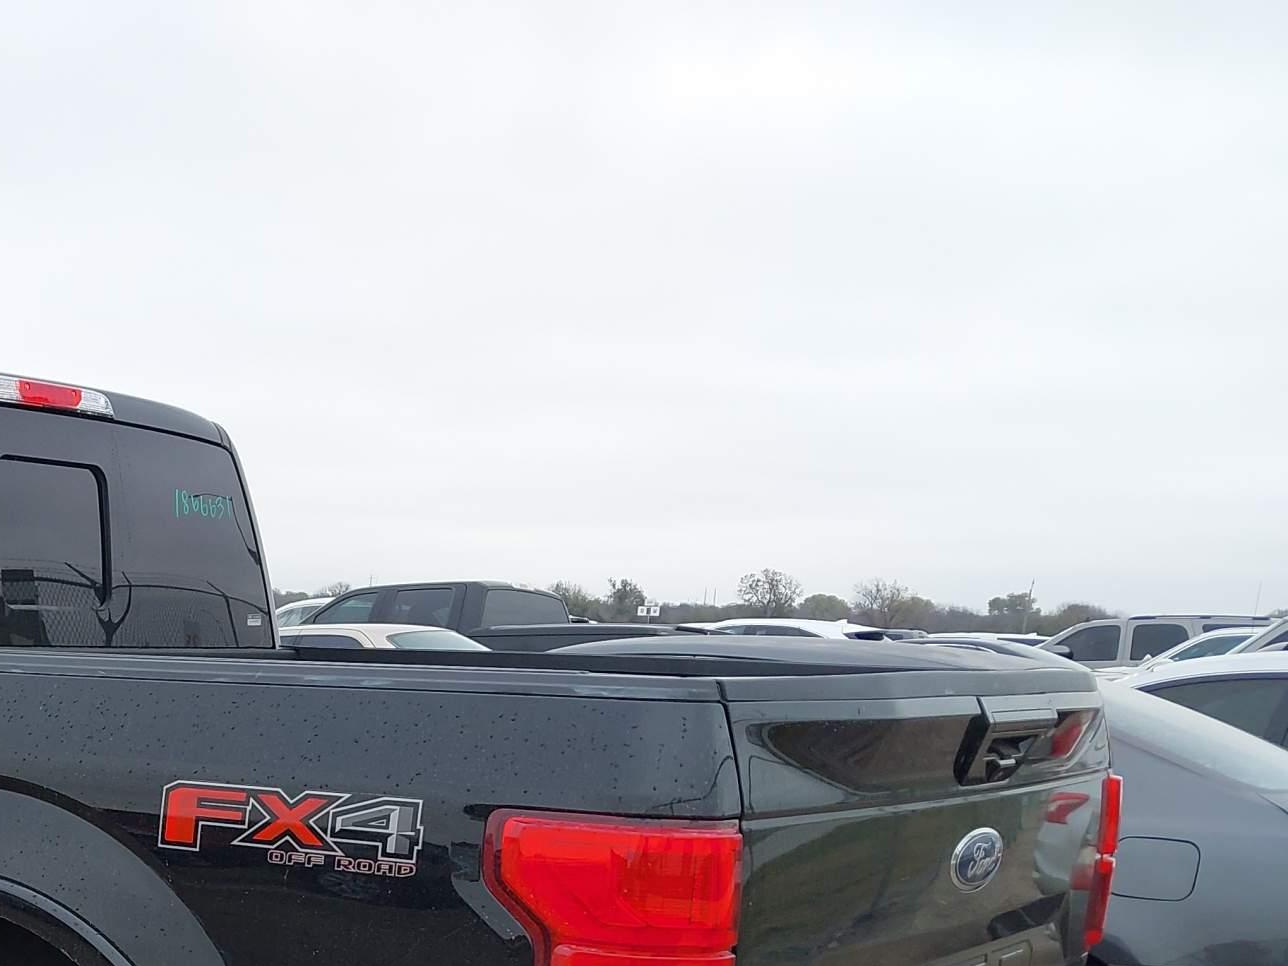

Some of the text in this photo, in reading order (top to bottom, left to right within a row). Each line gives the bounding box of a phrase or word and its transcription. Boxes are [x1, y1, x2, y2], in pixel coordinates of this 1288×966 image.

[158, 780, 423, 863] FX4
[267, 850, 417, 878] OFF ROAD
